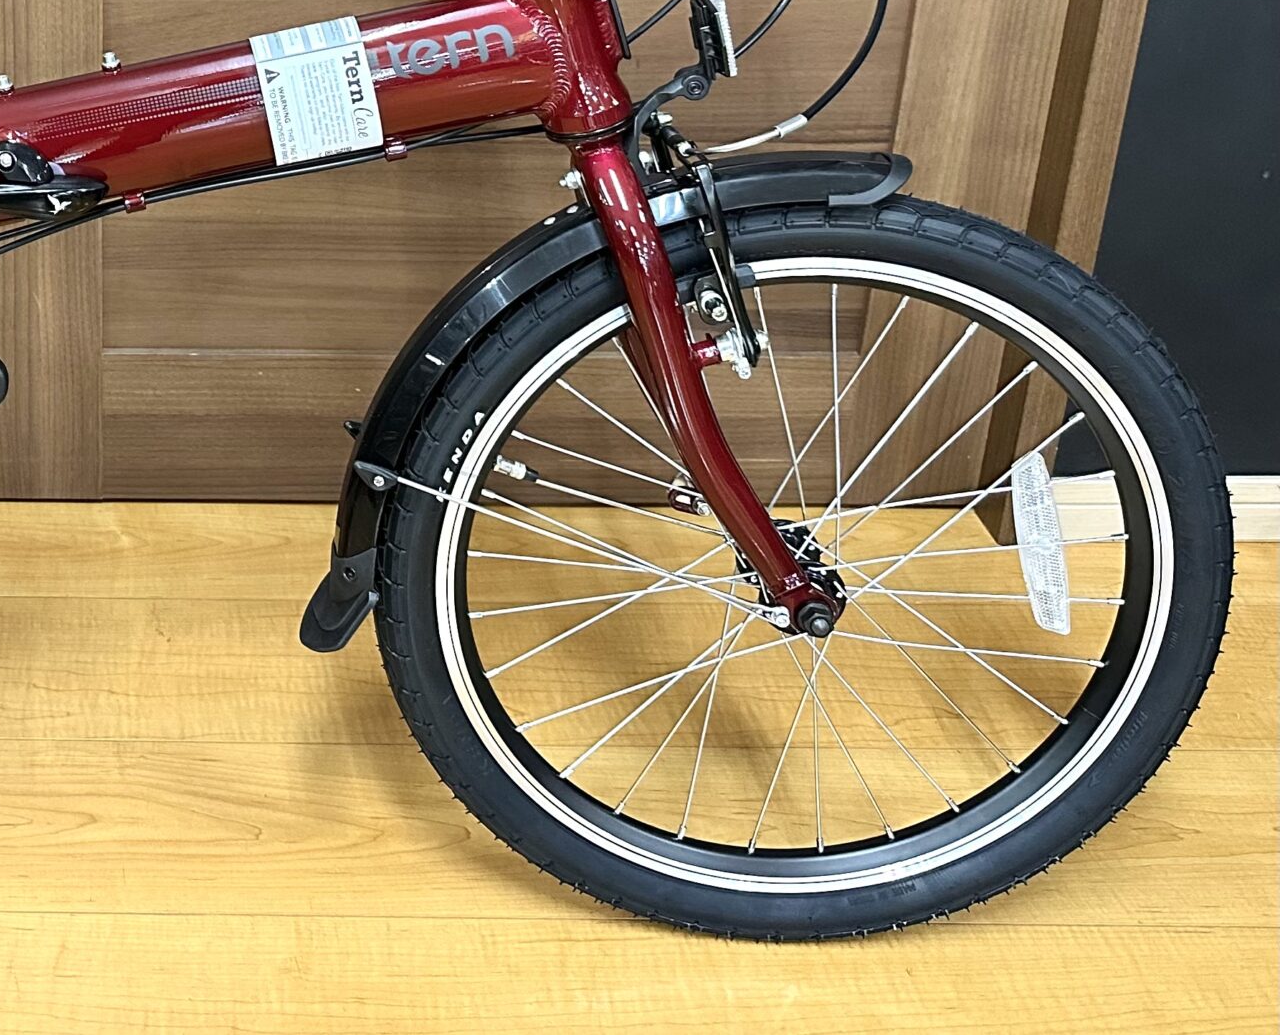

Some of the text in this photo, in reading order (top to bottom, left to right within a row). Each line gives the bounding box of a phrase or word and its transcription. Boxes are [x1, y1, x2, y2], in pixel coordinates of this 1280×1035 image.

[386, 24, 516, 79] tern
[269, 88, 277, 99] TO
[271, 100, 279, 109] BE
[278, 86, 292, 124] WARNING
[342, 50, 374, 139] Tern Care
[273, 110, 286, 142] REMOVED
[436, 411, 485, 503] KENDA
